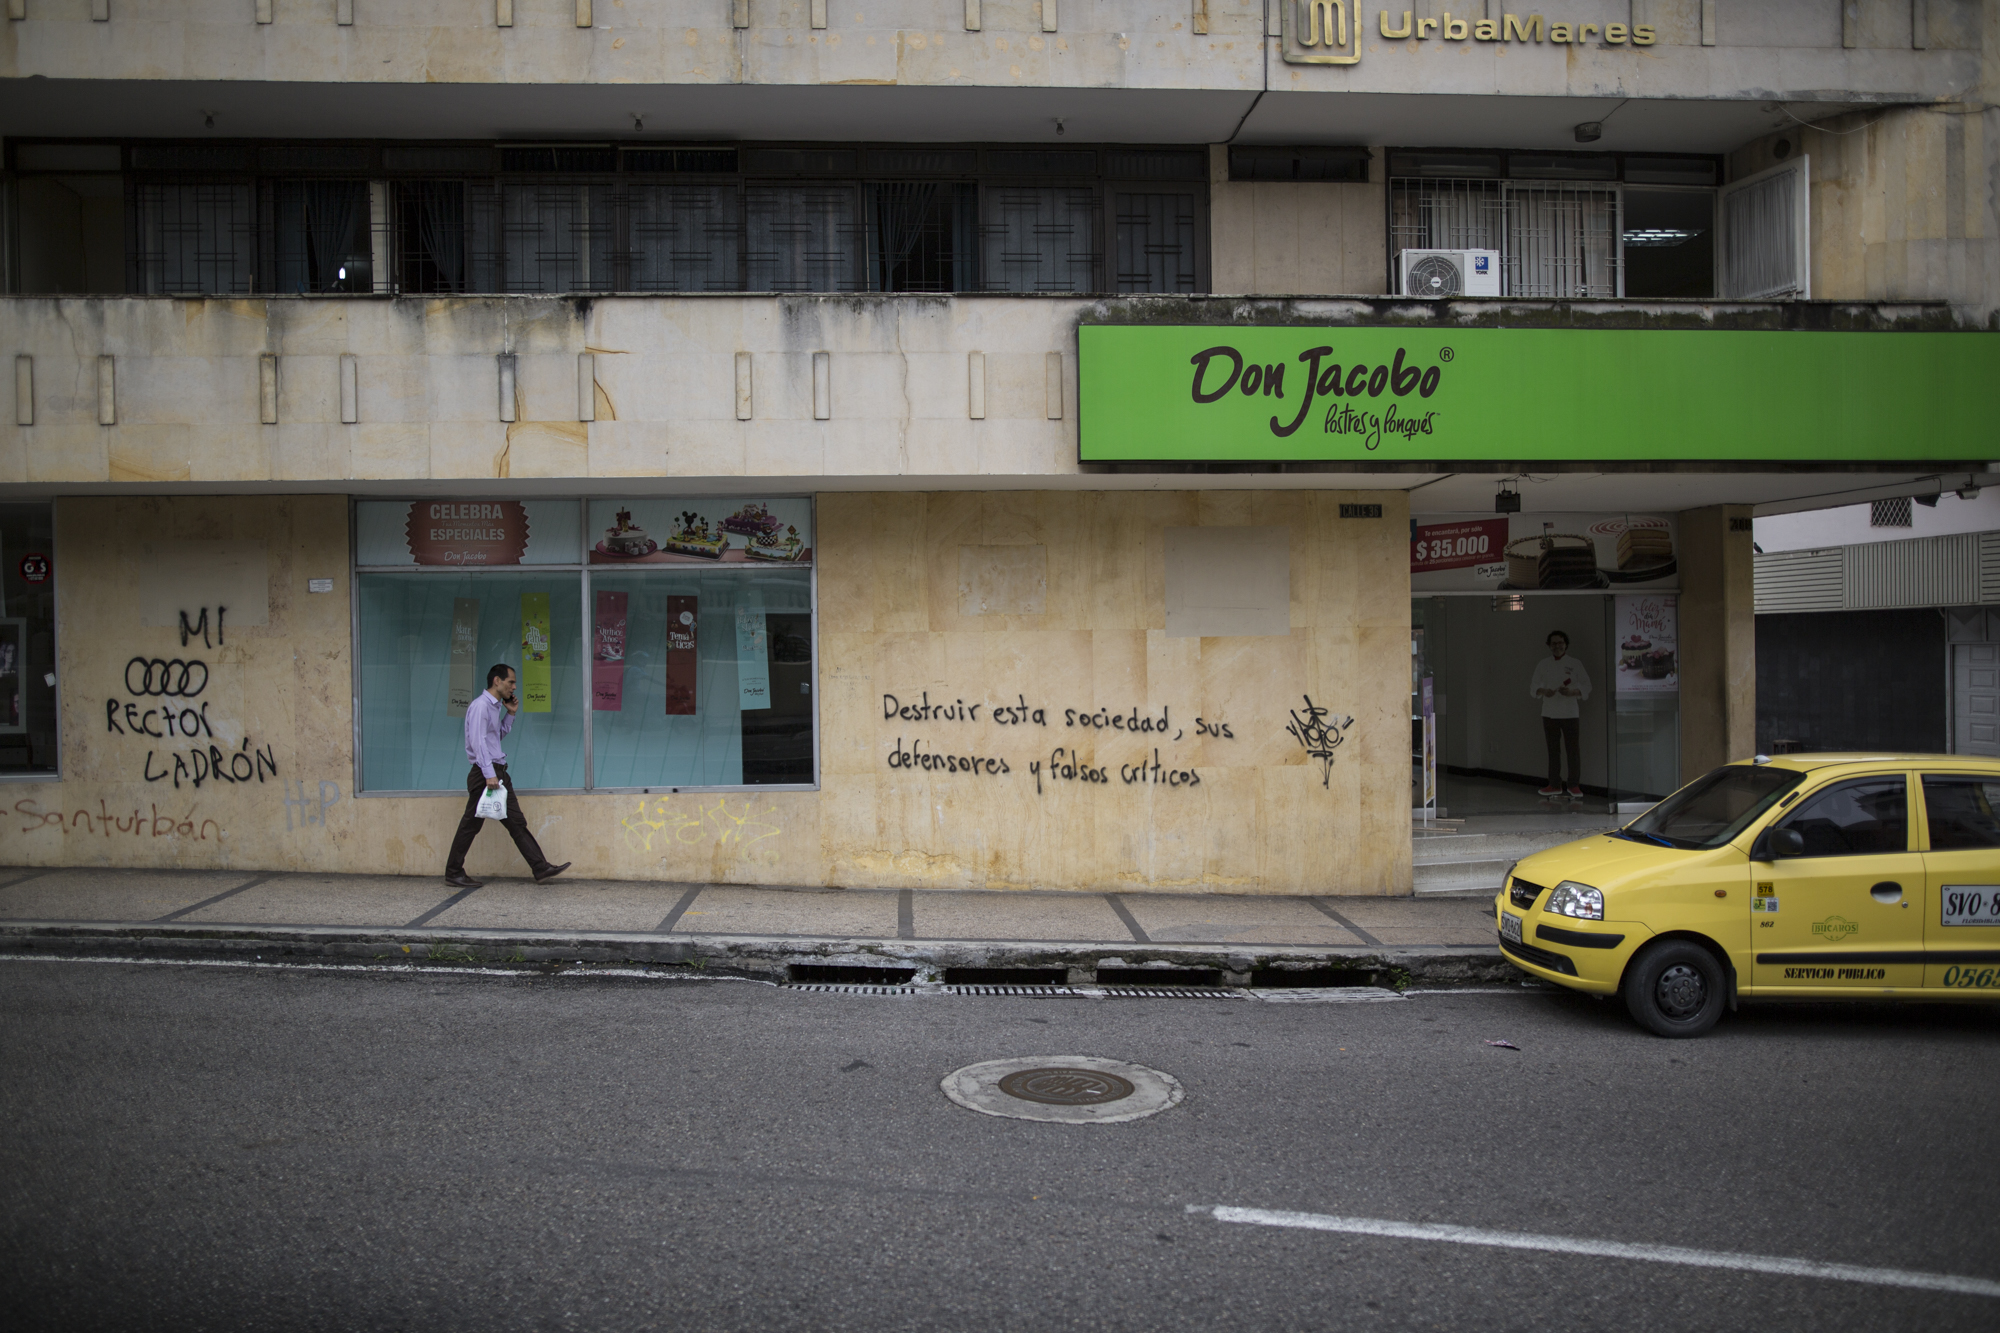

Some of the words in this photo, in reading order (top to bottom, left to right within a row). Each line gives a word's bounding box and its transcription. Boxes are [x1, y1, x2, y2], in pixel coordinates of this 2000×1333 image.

[1379, 10, 1656, 45] UrbaMares
[1190, 345, 1286, 403] Don
[1365, 413, 1380, 451] y
[429, 504, 504, 520] CELEBRA
[1342, 504, 1367, 518] CALLE
[1368, 505, 1379, 518] 36
[430, 528, 505, 541] ESPECIALES
[1461, 527, 1470, 535] por
[444, 551, 460, 562] Don
[179, 606, 226, 649] MI
[1629, 613, 1667, 634] Mamá
[599, 627, 624, 637] Quince
[669, 631, 690, 641] Temá
[675, 640, 695, 649] ticas
[883, 691, 981, 721] Destruir
[993, 694, 1047, 727] esta
[1195, 717, 1235, 739] sus
[144, 737, 277, 788] LADRÓN
[887, 737, 1011, 776] defensores
[1029, 760, 1042, 795] y
[1050, 748, 1108, 784] falsos
[14, 798, 222, 843] Santurbán
[1758, 885, 1774, 894] 578
[1759, 921, 1775, 929] 862
[1814, 924, 1857, 932] BUCAROS
[1784, 967, 1835, 979] SERVICIO
[1837, 968, 1886, 980] PUBLICO
